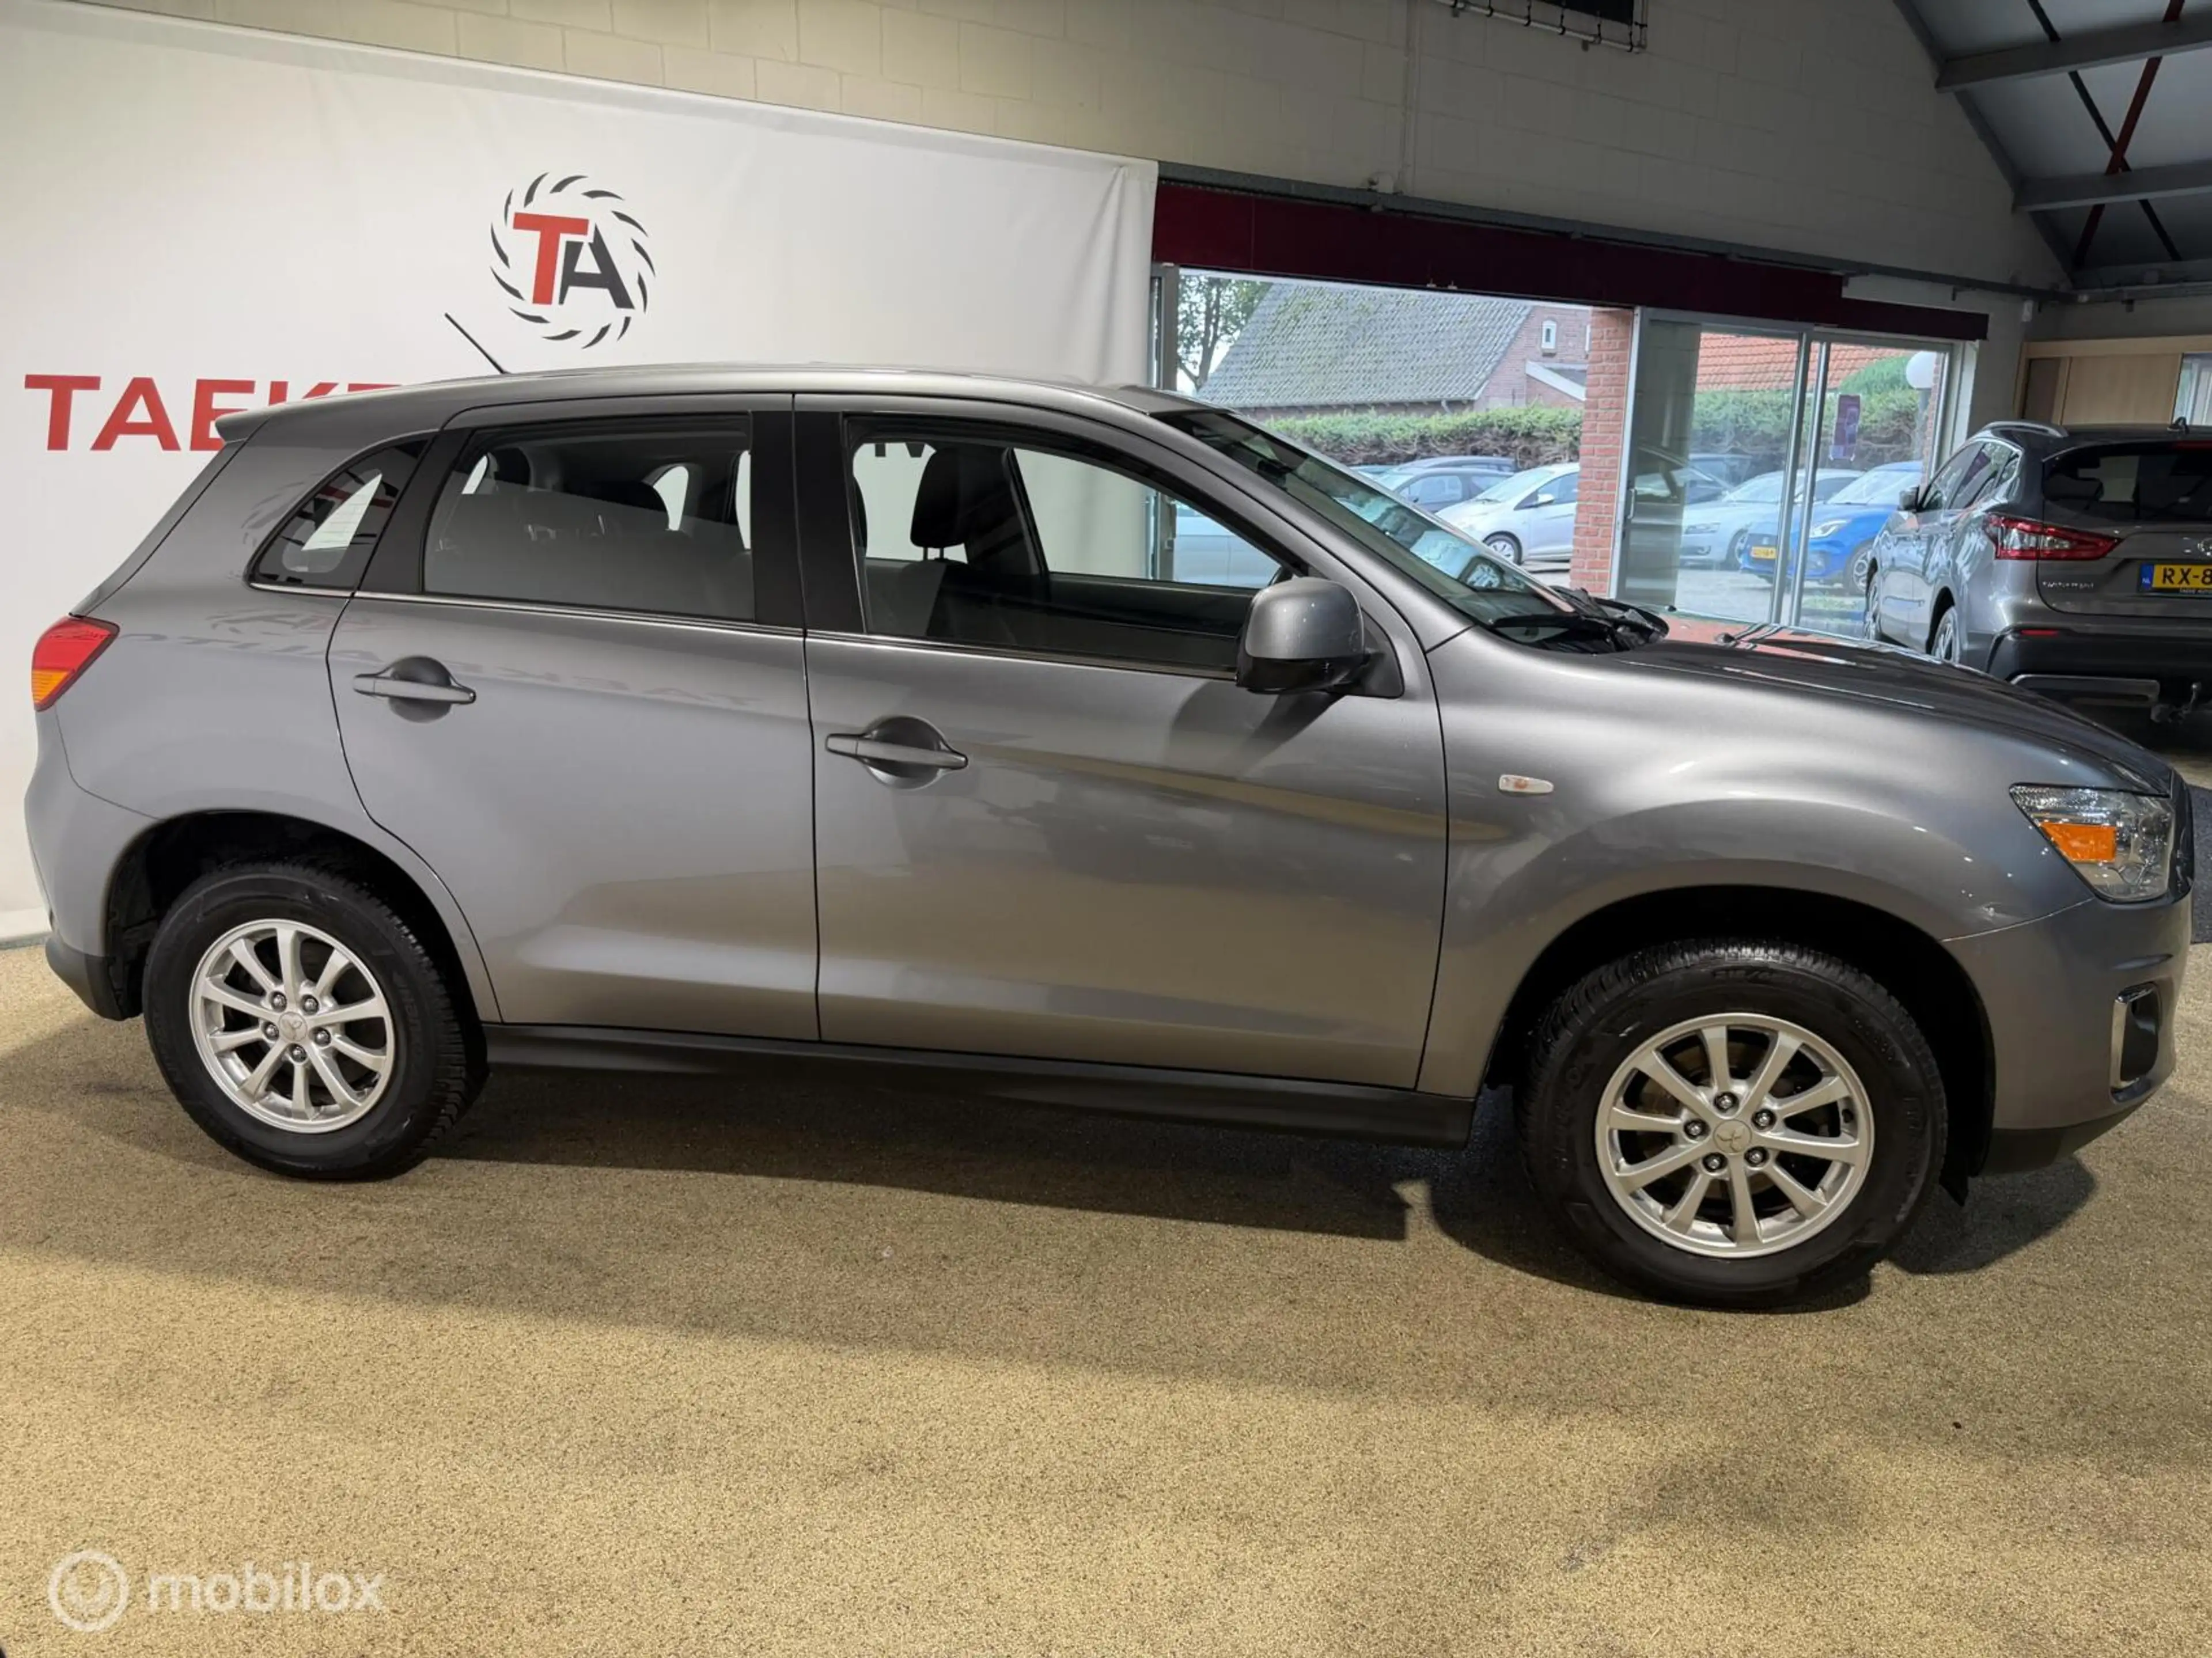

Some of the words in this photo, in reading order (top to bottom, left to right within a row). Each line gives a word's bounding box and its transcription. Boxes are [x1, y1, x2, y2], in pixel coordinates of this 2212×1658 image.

[513, 212, 635, 309] TA
[24, 374, 403, 452] TAE
[2162, 567, 2212, 585] RX-8
